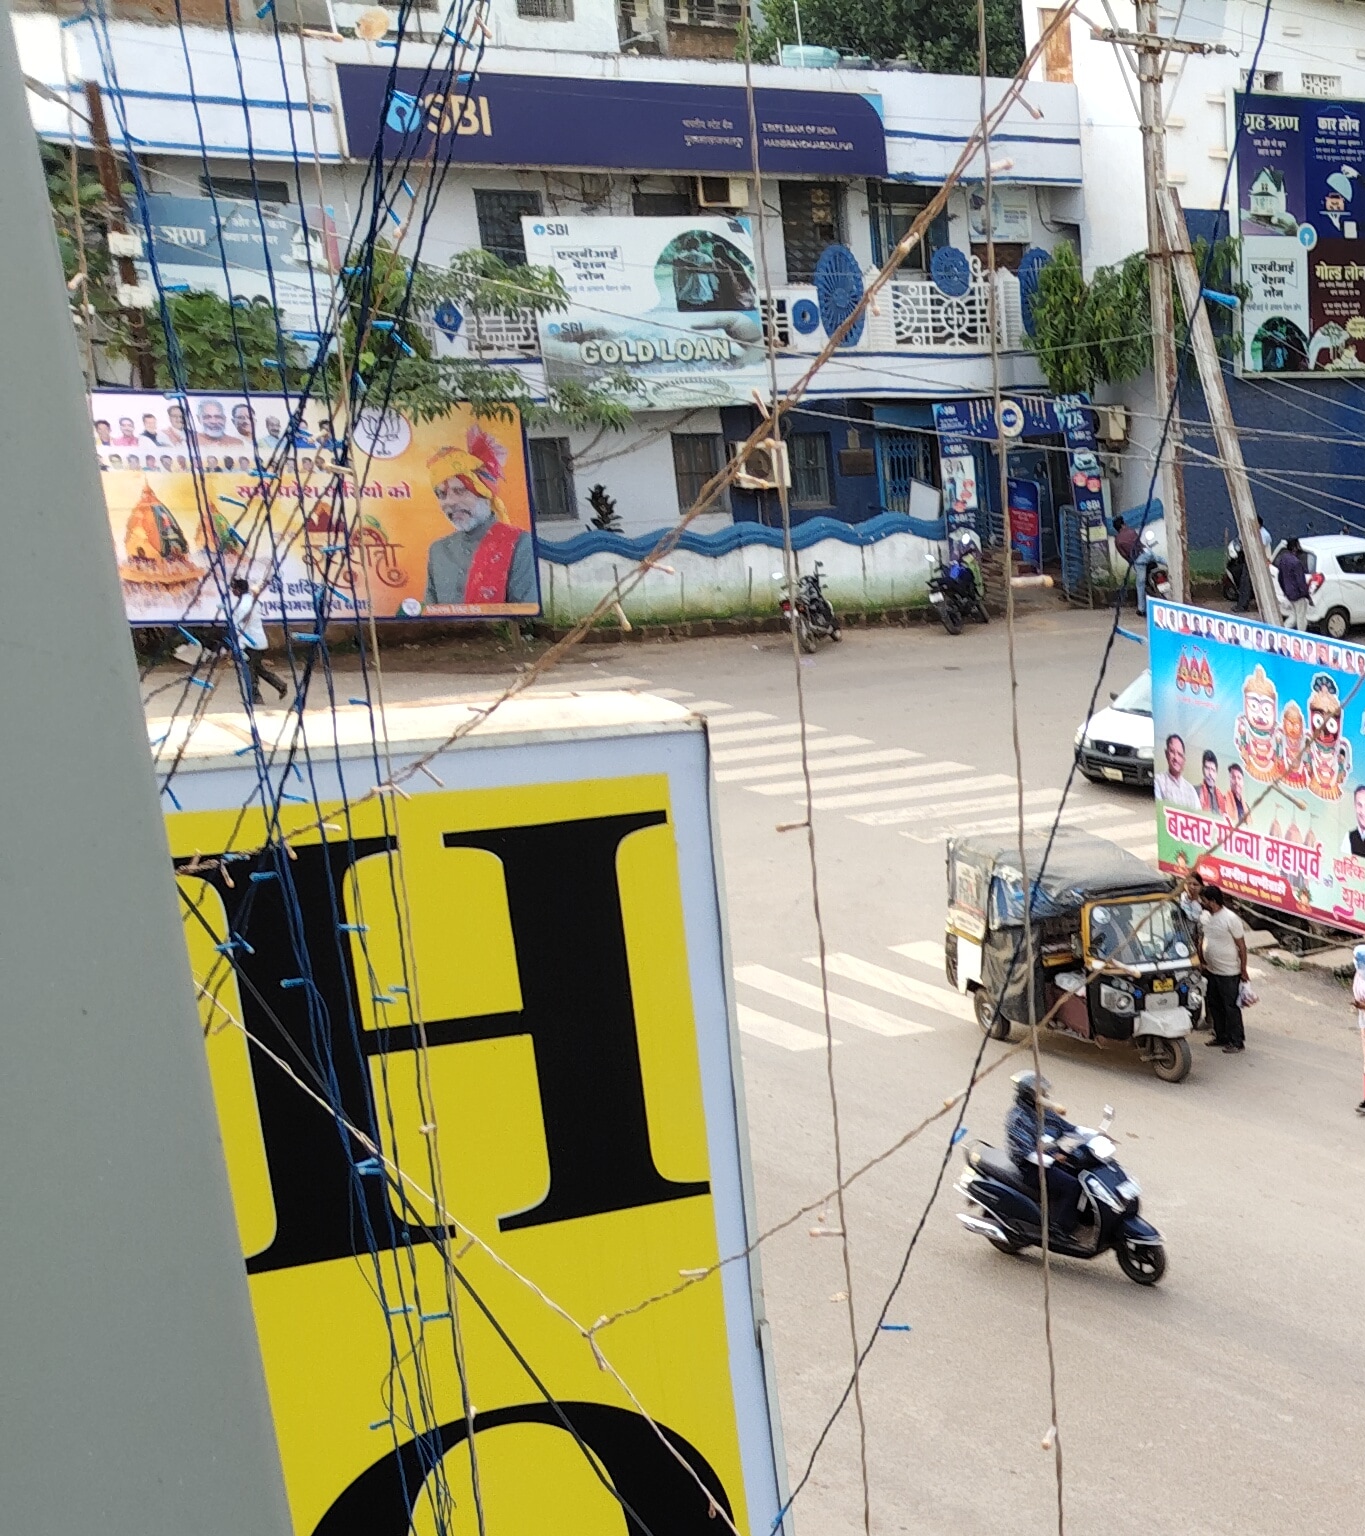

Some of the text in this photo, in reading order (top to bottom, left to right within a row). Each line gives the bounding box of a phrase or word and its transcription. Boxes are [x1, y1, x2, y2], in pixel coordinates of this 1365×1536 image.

[425, 94, 492, 137] SBI
[1338, 115, 1360, 132] लोन
[547, 224, 569, 236] SBI
[1315, 261, 1342, 280] गोल्ड
[561, 322, 583, 334] SBI
[580, 338, 731, 365] GOLD LOAN
[1165, 808, 1212, 848] बस्तर
[1215, 815, 1261, 861] गोन्चा
[1265, 837, 1322, 879] महापर्व
